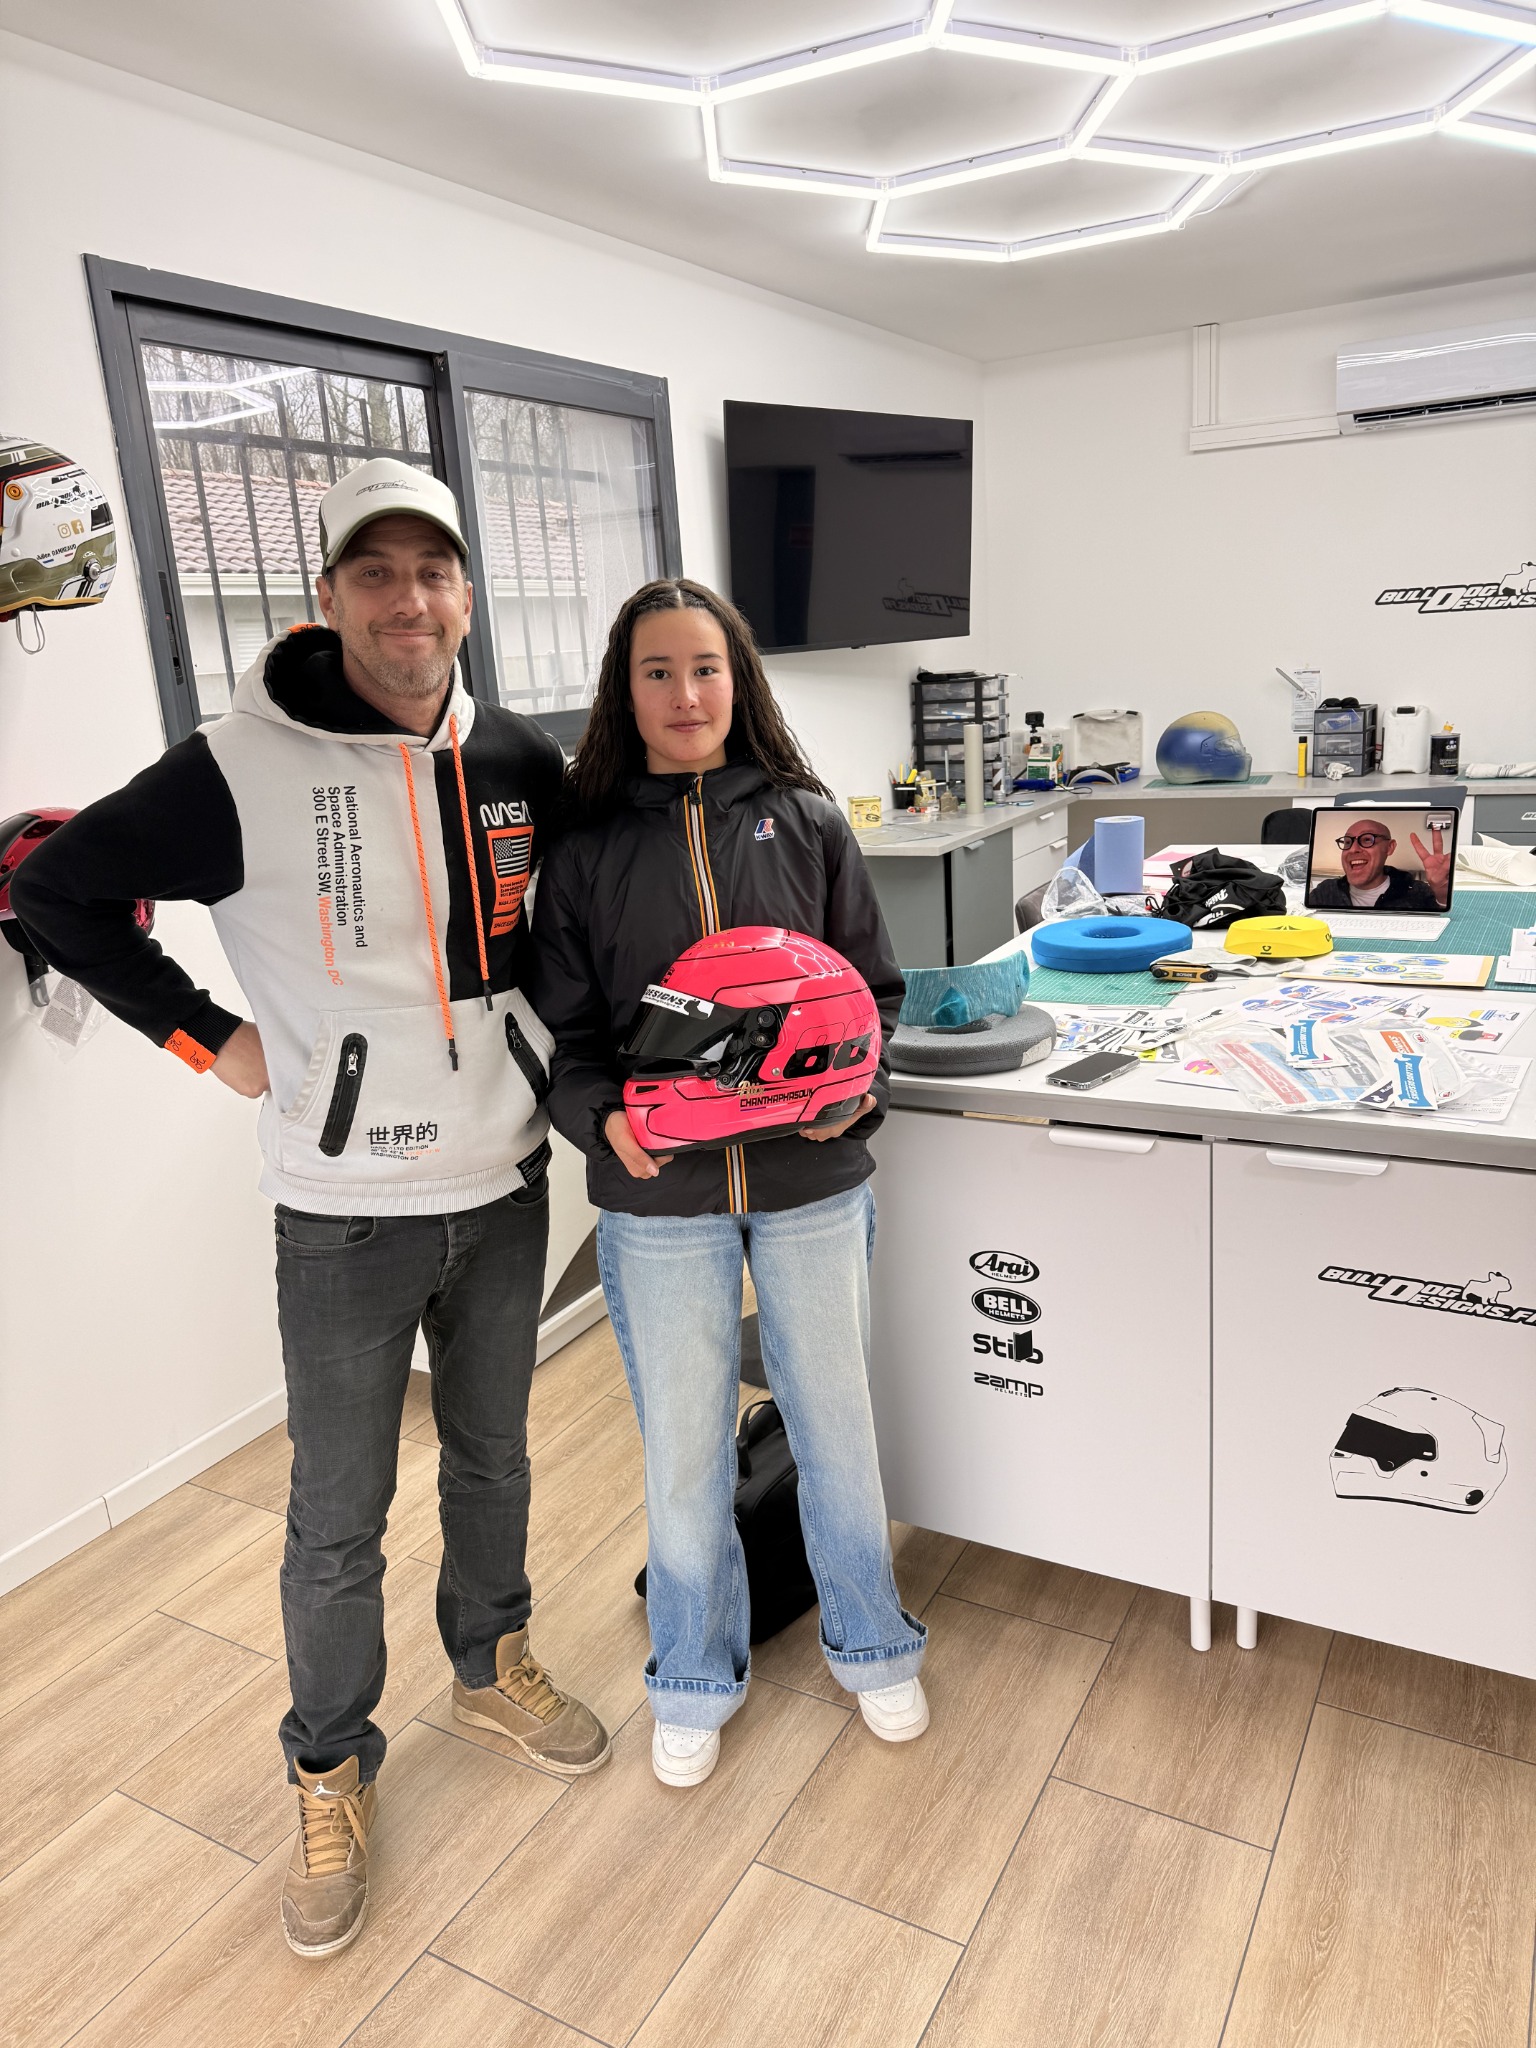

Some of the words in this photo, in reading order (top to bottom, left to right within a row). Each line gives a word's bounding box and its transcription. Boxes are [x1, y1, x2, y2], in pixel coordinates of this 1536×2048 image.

[312, 787, 327, 811] 300
[326, 786, 343, 828] Space
[315, 815, 328, 824] E
[343, 785, 362, 840] National
[480, 800, 533, 828] NASA
[316, 828, 331, 869] Street
[316, 872, 332, 896] SW,
[333, 831, 349, 926] Administration
[350, 843, 366, 922] Aeronautics
[318, 896, 336, 967] Washington
[354, 925, 368, 948] and
[327, 969, 344, 986] DC
[366, 1121, 438, 1146] 世界的
[370, 1152, 409, 1160] WASHINGTON
[974, 1253, 1031, 1276] Arai
[992, 1272, 1017, 1280] HELMET
[983, 1293, 1032, 1316] BELL
[988, 1308, 1026, 1320] HELMETS
[973, 1333, 1043, 1364] Stio
[974, 1371, 1044, 1398] zamp
[994, 1387, 1028, 1397] HELMETS
